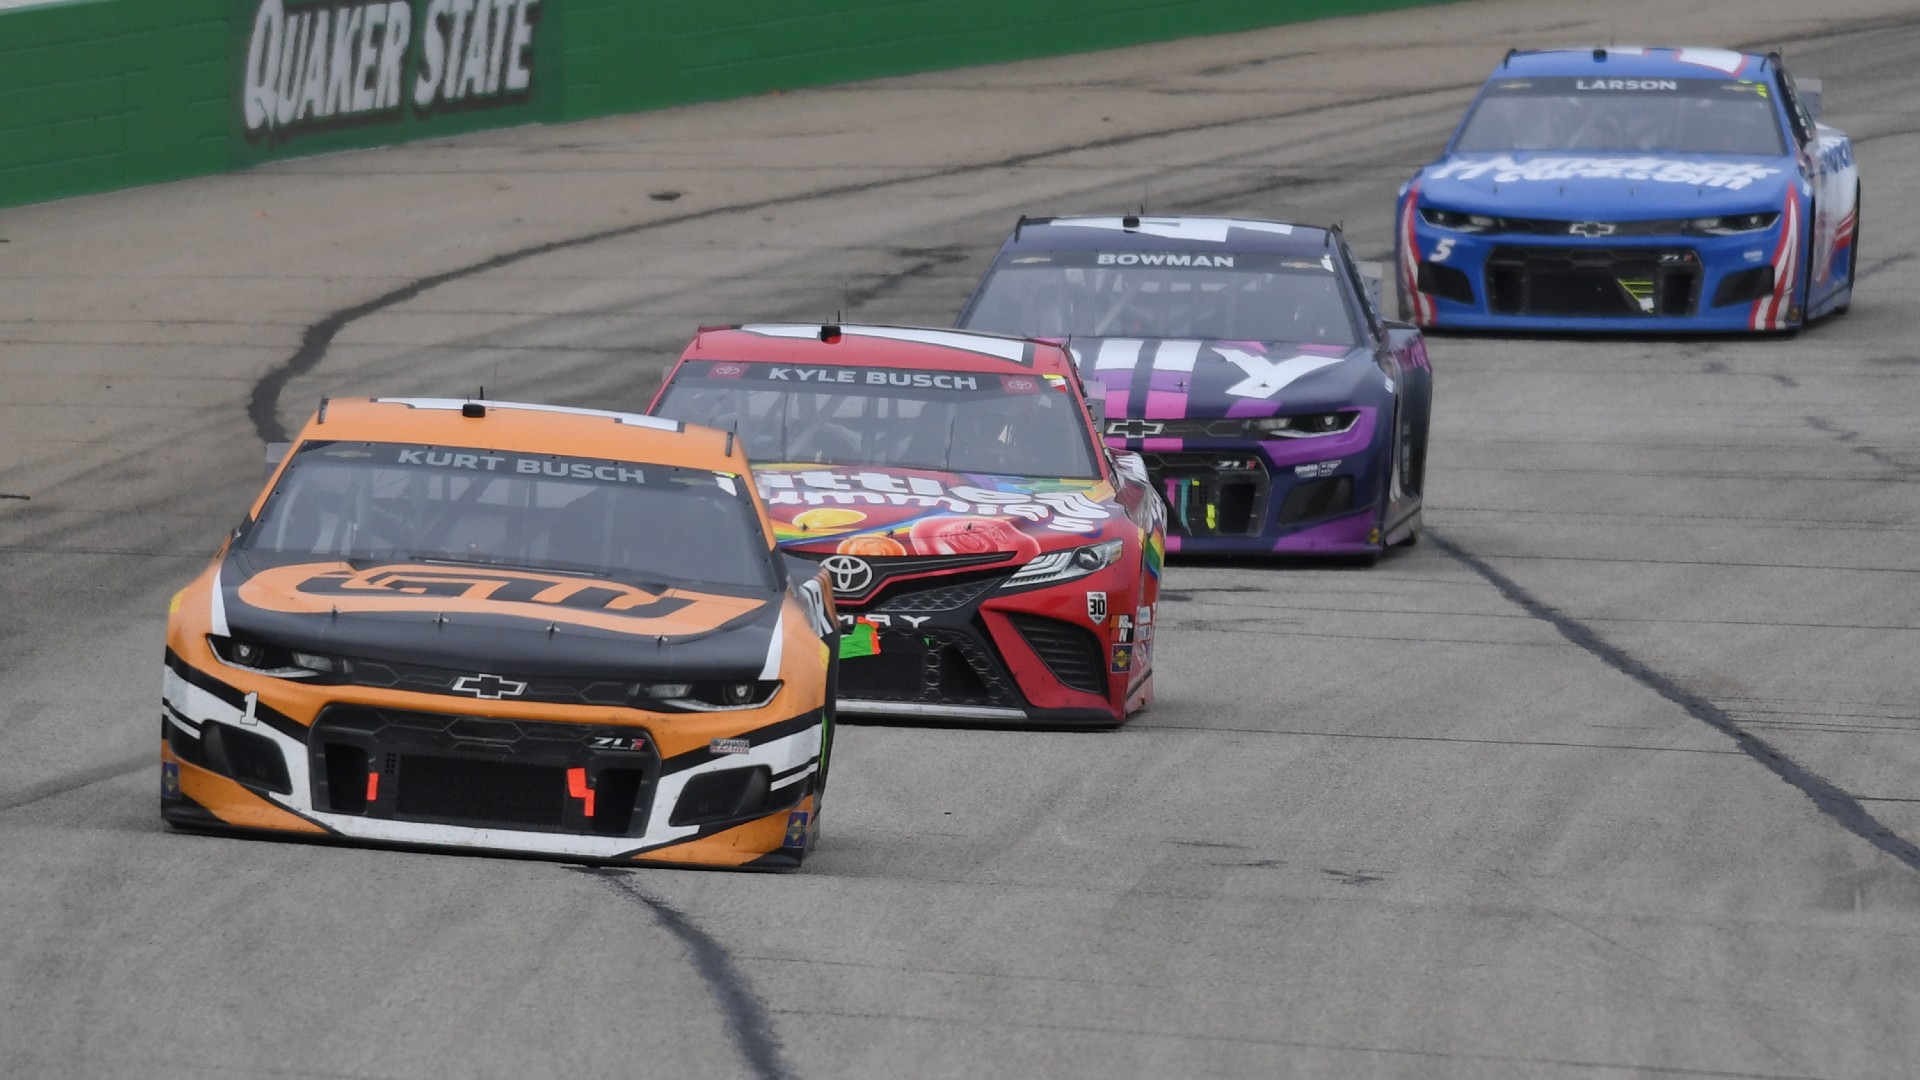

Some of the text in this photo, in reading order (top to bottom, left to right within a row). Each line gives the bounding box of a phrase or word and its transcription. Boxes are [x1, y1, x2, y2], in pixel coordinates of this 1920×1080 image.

[244, 0, 539, 130] QUAKER STATE
[1576, 80, 1677, 91] LARSON
[1097, 254, 1234, 268] BOWMAN
[1429, 239, 1456, 262] 5
[768, 368, 978, 391] KYLE BUSCH
[398, 449, 646, 485] KURT BUSCH
[1089, 599, 1106, 616] 30
[240, 691, 259, 726] 1
[589, 736, 646, 751] ZL1
